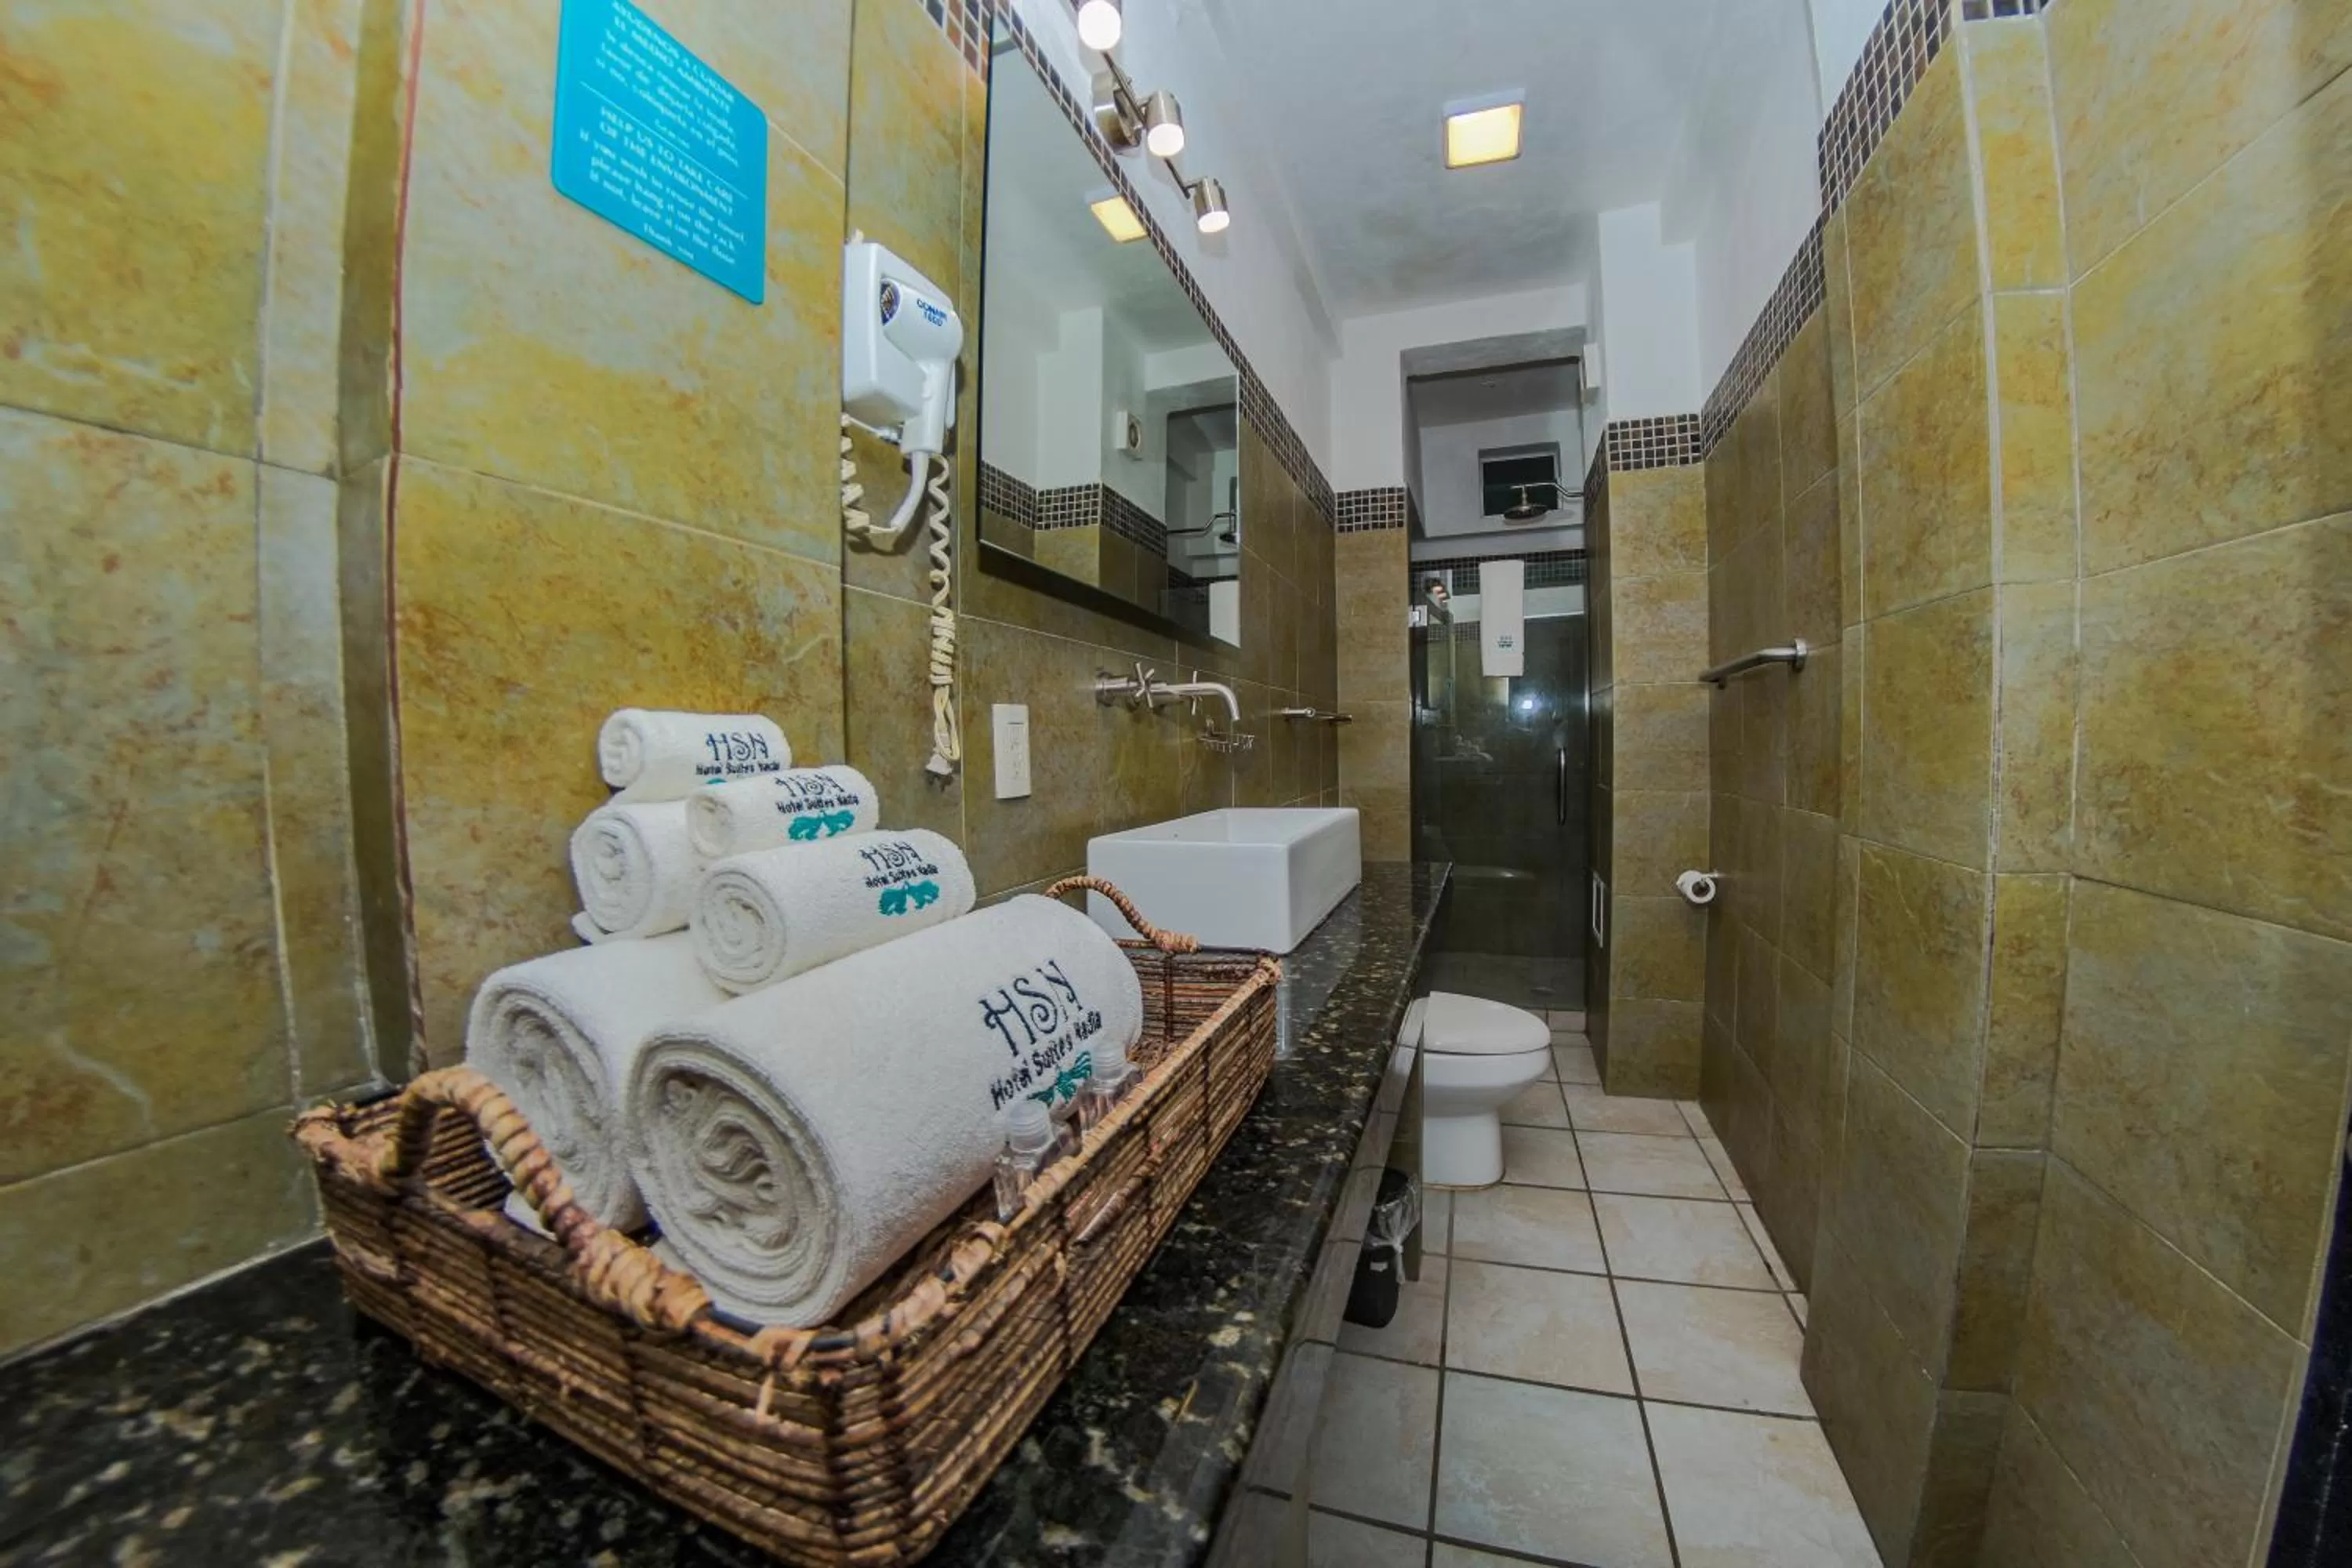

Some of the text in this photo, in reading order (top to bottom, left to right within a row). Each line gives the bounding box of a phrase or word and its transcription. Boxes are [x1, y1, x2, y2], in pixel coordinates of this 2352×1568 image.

[601, 106, 635, 135] HELP
[678, 159, 702, 182] TAKE
[707, 180, 732, 202] CARE
[624, 136, 646, 158] THE
[651, 155, 732, 214] ENVIRONMENT
[692, 233, 709, 248] the
[694, 220, 710, 234] the
[706, 731, 768, 761] HSN
[775, 773, 845, 797] HSN
[859, 842, 922, 871] HSN
[978, 960, 1083, 1057] HSN
[990, 1058, 1033, 1111] Hotel
[1032, 1033, 1073, 1076] Suites
